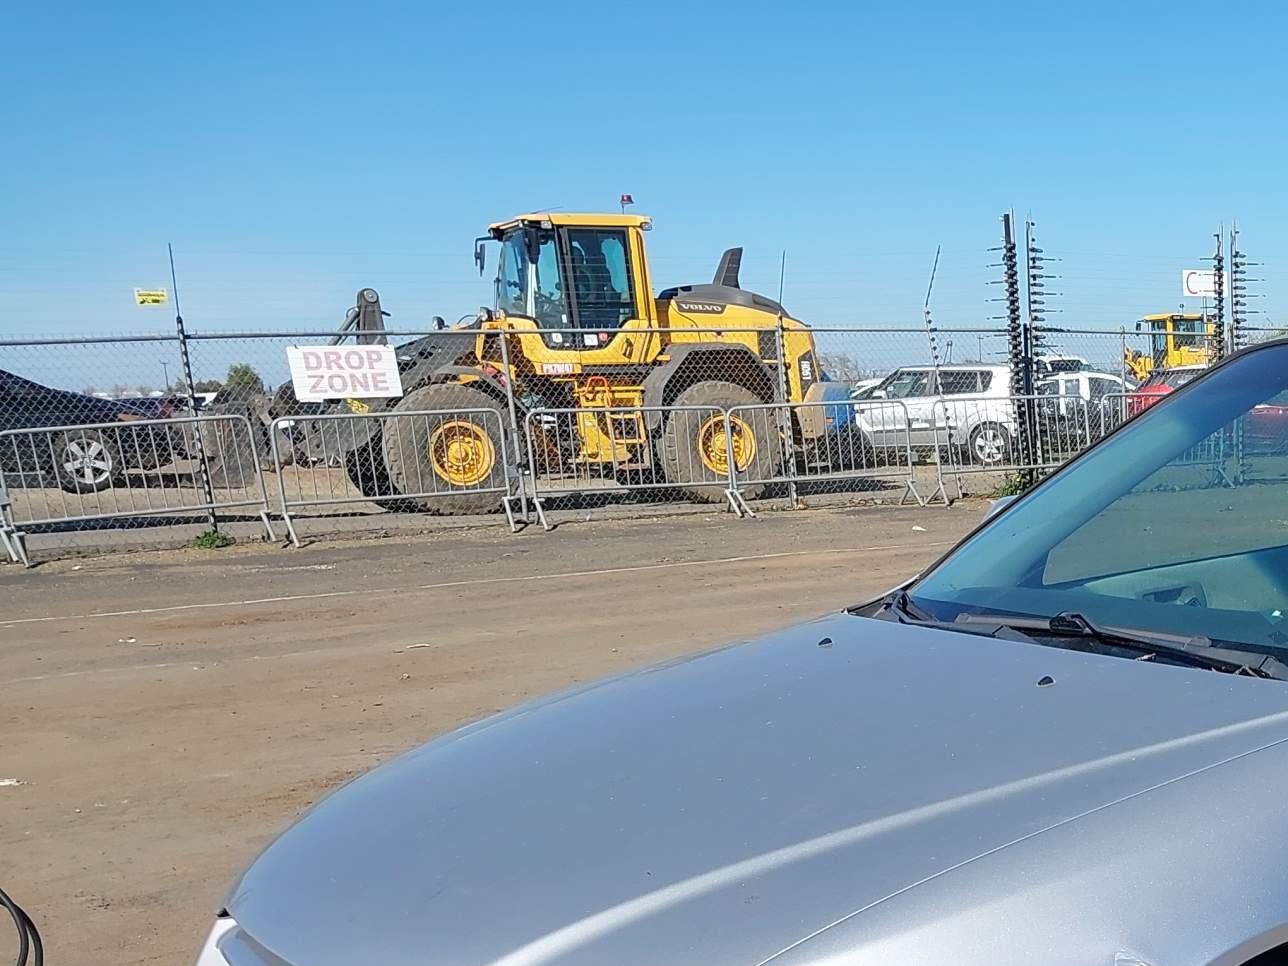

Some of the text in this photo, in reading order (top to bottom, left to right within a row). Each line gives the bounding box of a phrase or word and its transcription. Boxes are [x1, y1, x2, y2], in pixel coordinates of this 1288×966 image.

[680, 303, 722, 312] VOLVO
[302, 350, 383, 371] DROP
[308, 371, 390, 394] ZONE
